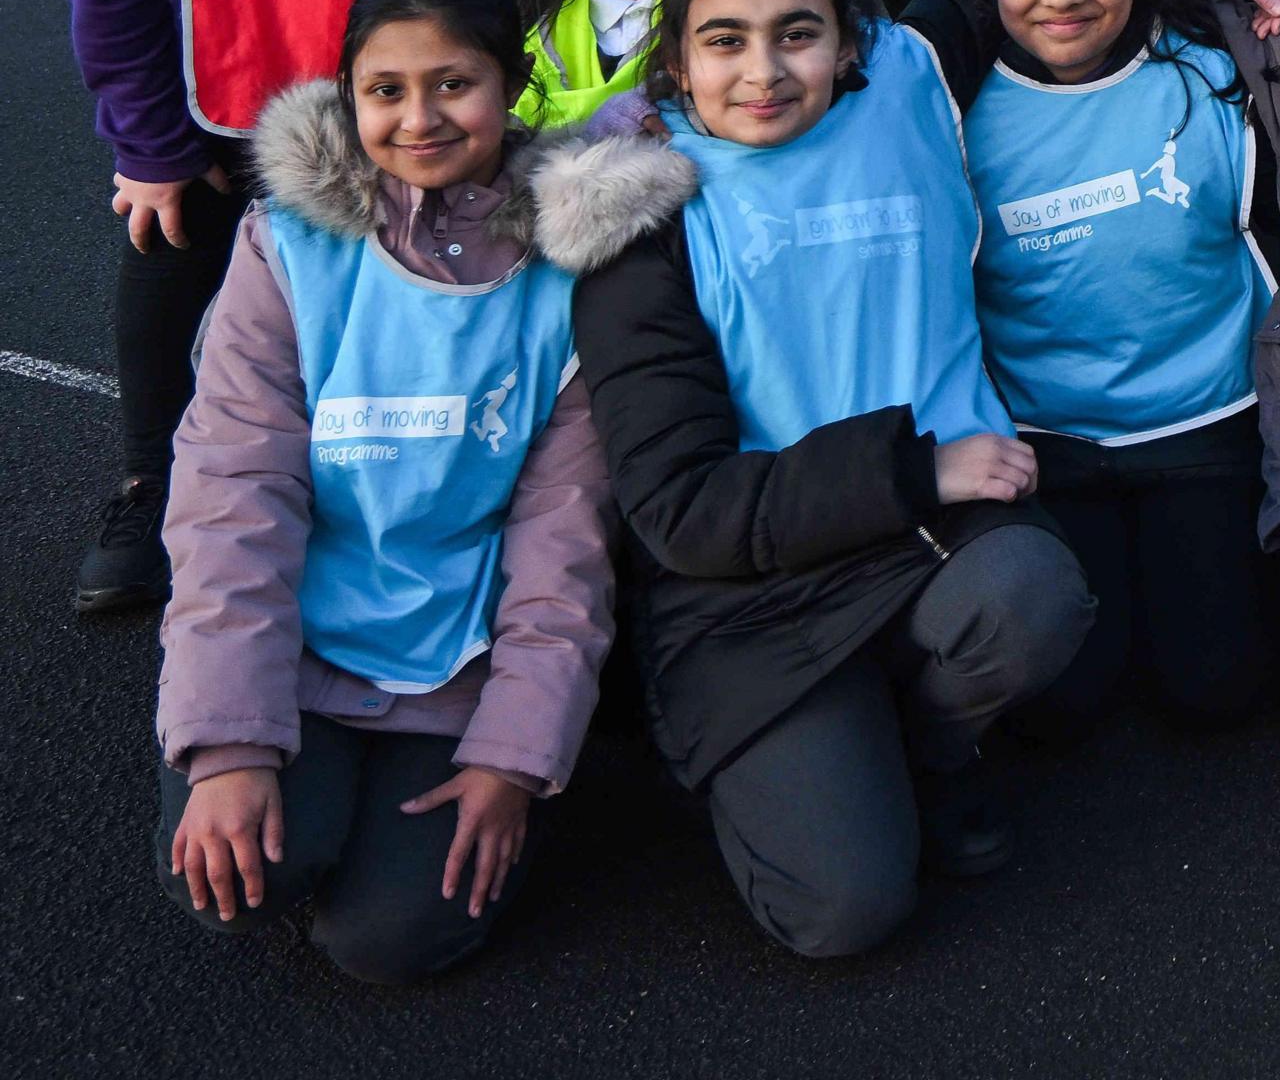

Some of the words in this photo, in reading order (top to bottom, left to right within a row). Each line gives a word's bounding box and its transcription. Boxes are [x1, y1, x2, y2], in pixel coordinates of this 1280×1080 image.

[1012, 208, 1043, 228] Joy
[1046, 198, 1063, 220] of
[1069, 183, 1127, 213] moving
[1018, 224, 1094, 252] Programme
[318, 410, 345, 434] Joy
[353, 405, 374, 428] of
[382, 405, 450, 431] moving
[317, 443, 400, 466] Programme
